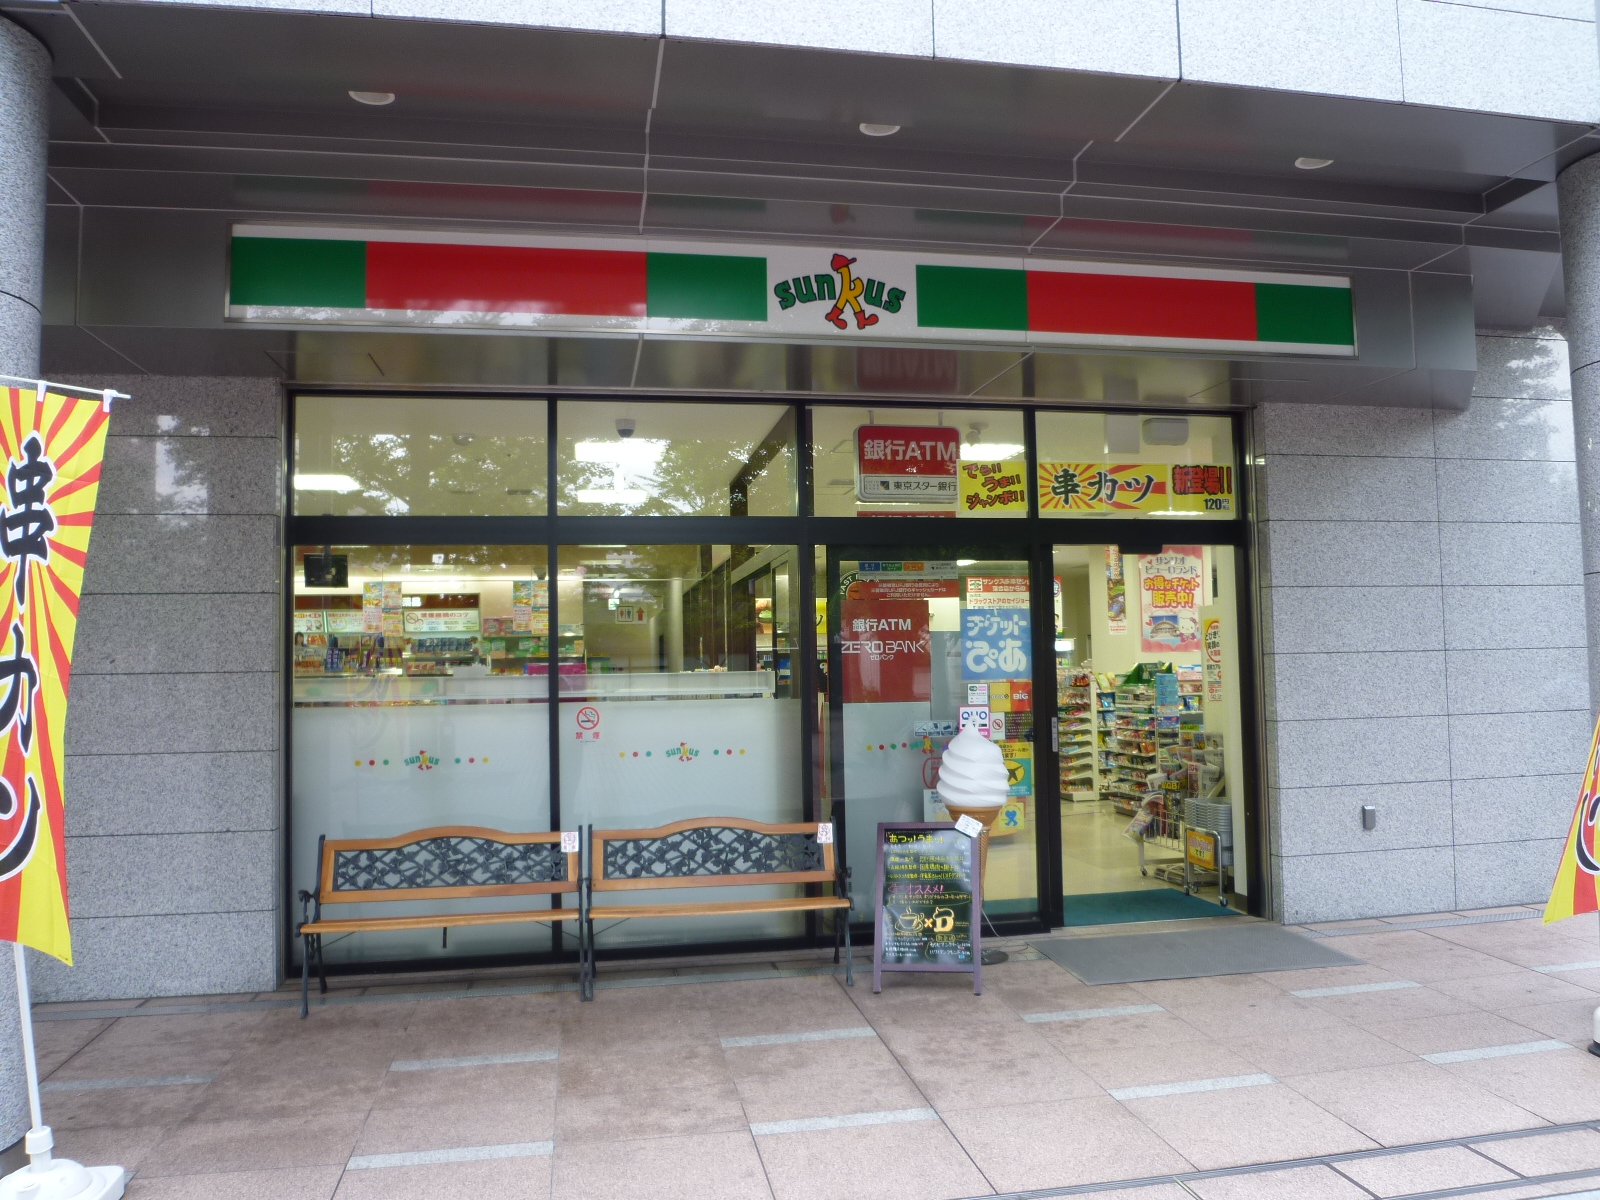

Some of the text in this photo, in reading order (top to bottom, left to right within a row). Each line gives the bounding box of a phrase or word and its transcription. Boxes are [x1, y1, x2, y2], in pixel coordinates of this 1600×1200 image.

[774, 253, 906, 330] sunkus
[864, 440, 956, 461] 銀行ATM
[893, 481, 957, 491] 東京スター銀行
[1051, 468, 1155, 505] 串カツ
[1154, 556, 1187, 566] サンリオ
[1144, 575, 1200, 592] お得なチケット
[1152, 591, 1194, 609] 販売中!
[852, 618, 912, 631] 銀行ATM
[966, 614, 1028, 636] チケット
[841, 640, 925, 653] ZERO BANK
[965, 638, 1027, 673] ぴあ
